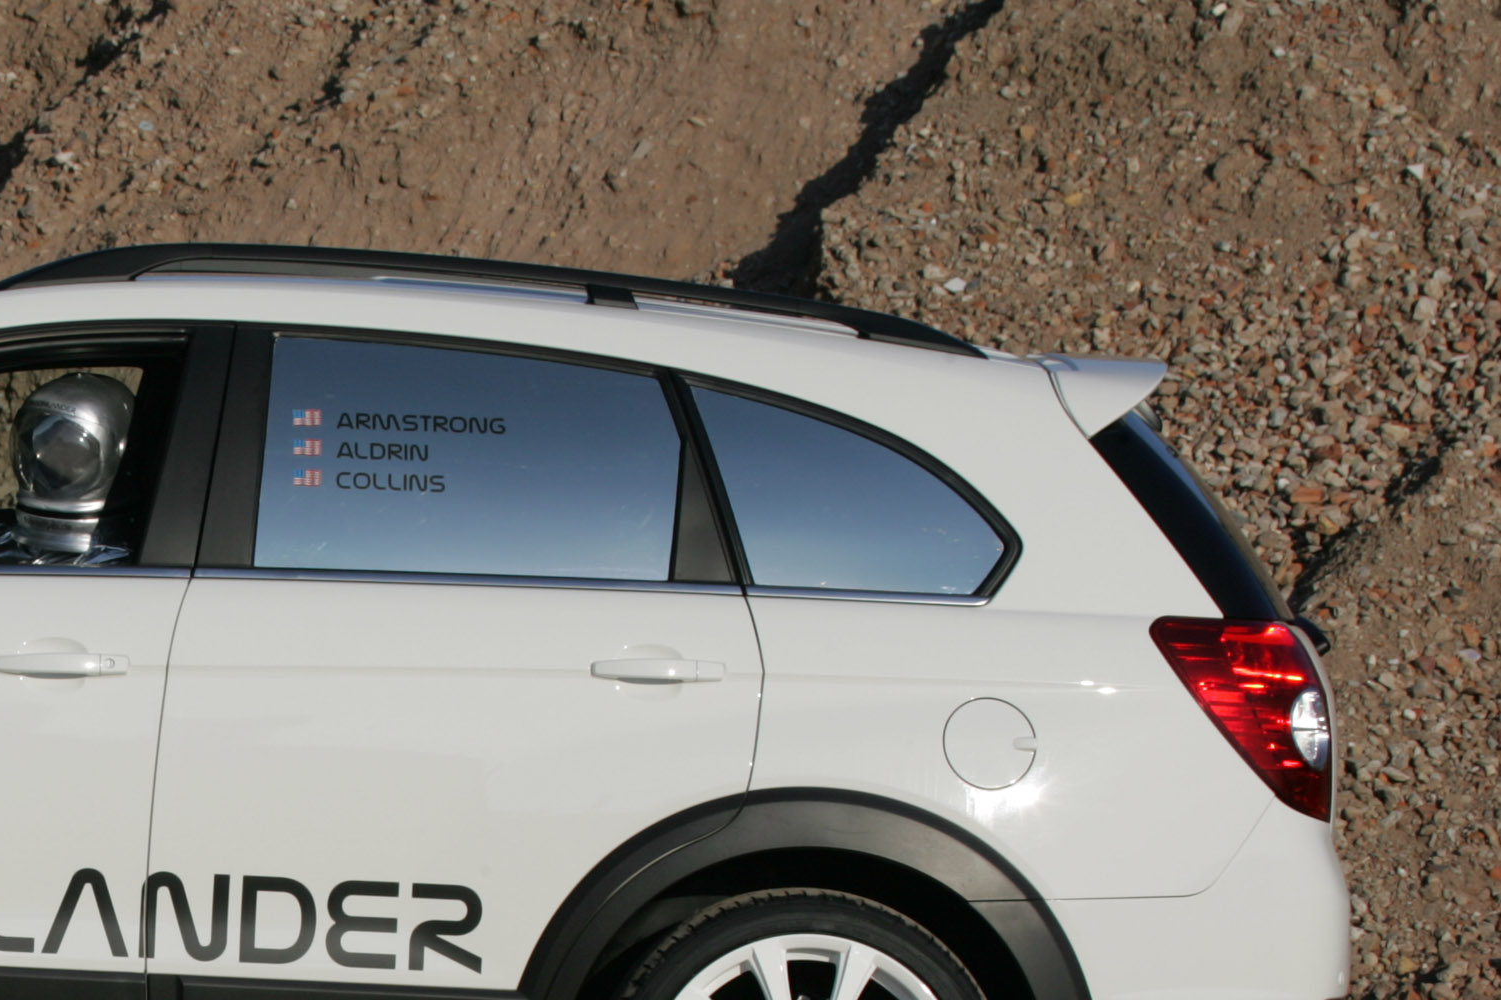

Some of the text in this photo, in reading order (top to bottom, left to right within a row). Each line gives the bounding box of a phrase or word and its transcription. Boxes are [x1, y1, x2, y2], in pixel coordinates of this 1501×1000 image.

[336, 412, 506, 435] ARMSTRONG
[336, 441, 429, 462] ALDRIN
[336, 471, 446, 493] COLLINS
